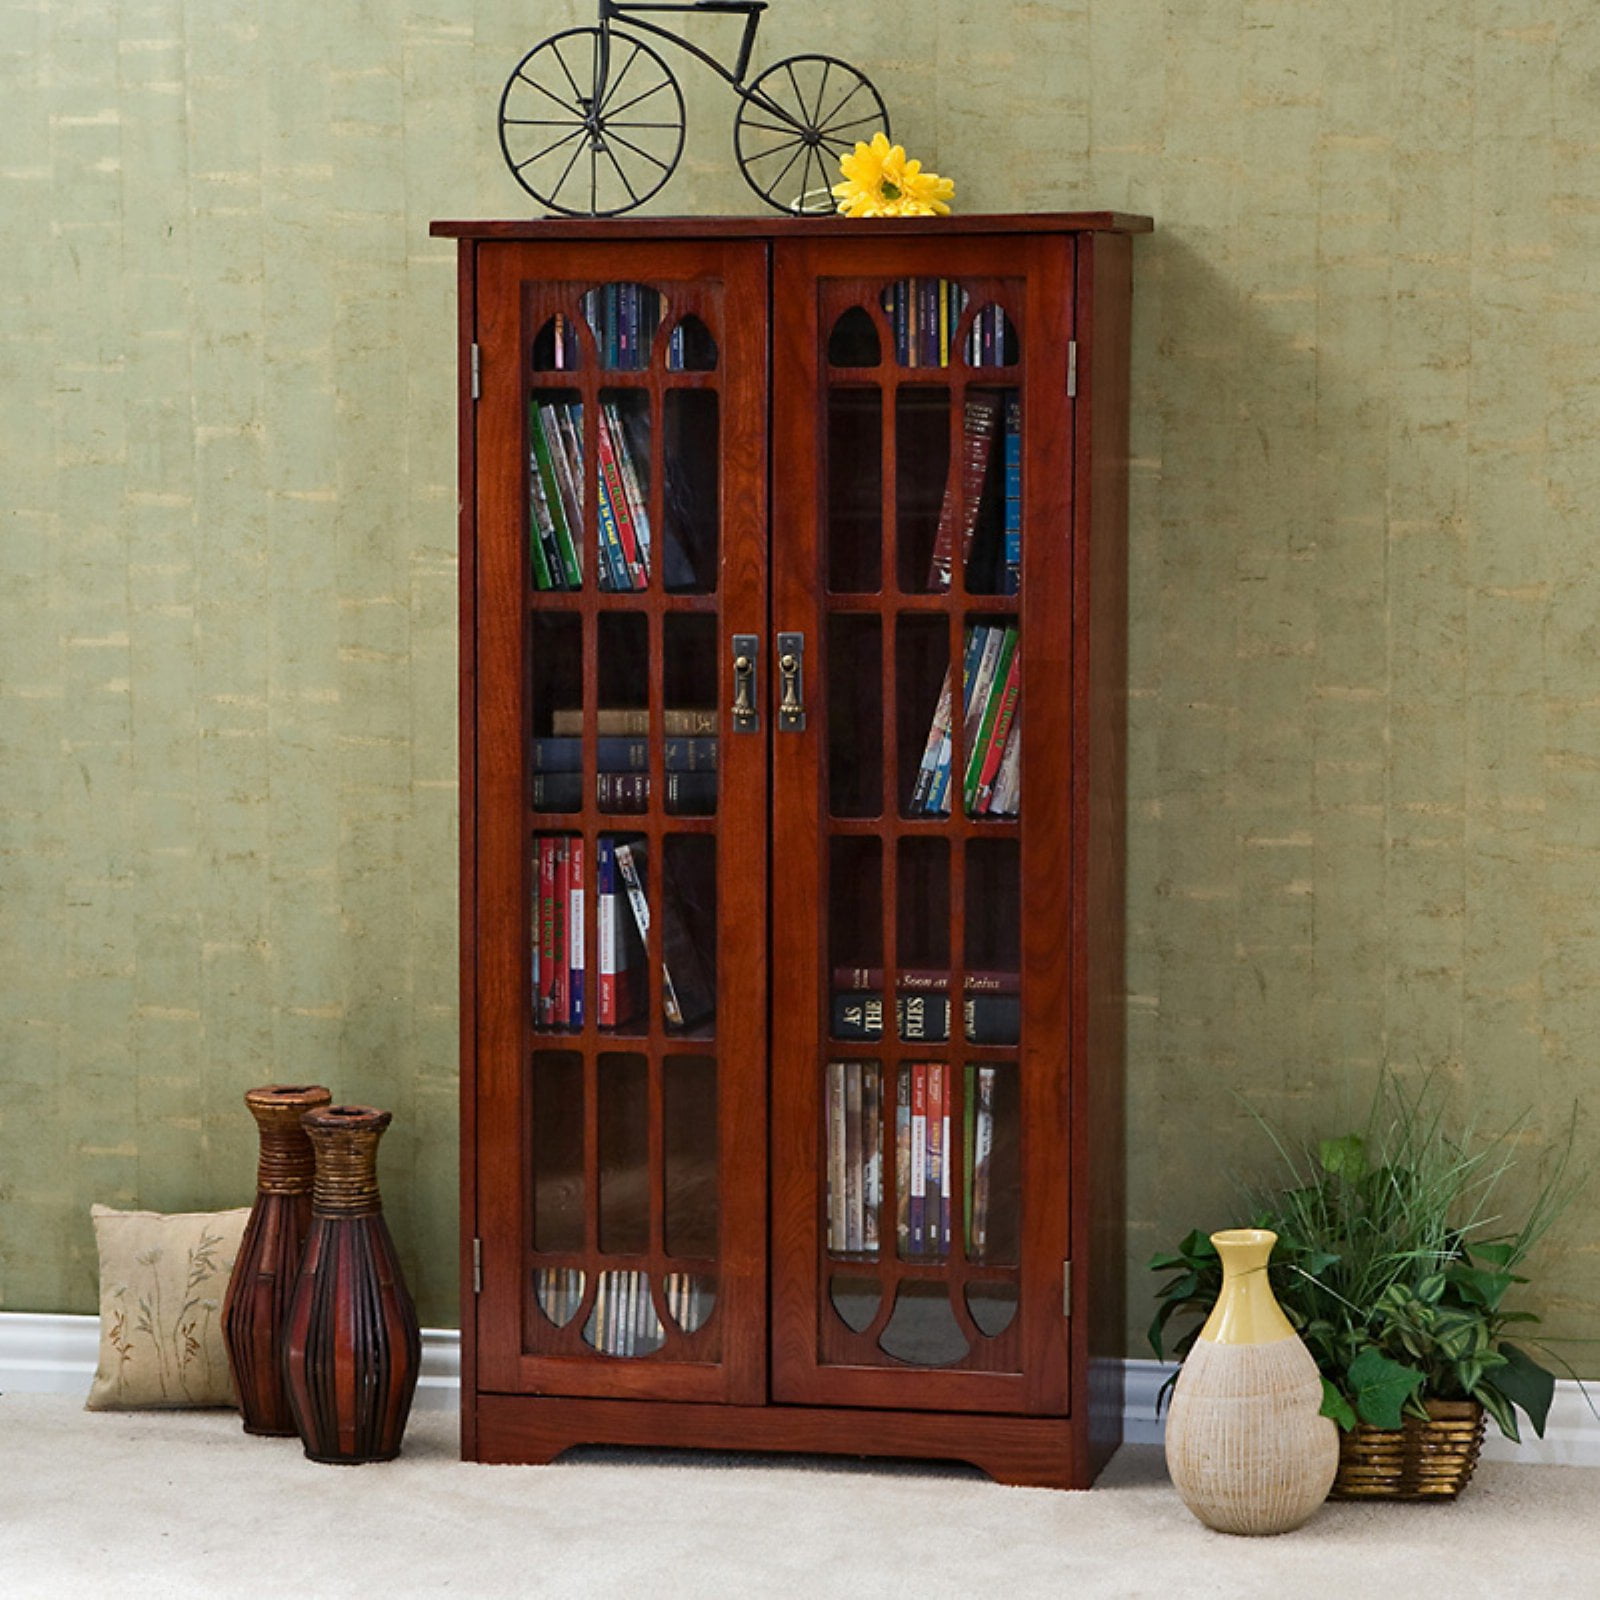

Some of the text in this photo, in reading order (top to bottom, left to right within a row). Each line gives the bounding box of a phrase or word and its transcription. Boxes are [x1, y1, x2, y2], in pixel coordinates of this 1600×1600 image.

[842, 1006, 862, 1027] AS
[864, 1000, 883, 1033] THE
[906, 997, 925, 1039] FLIES
